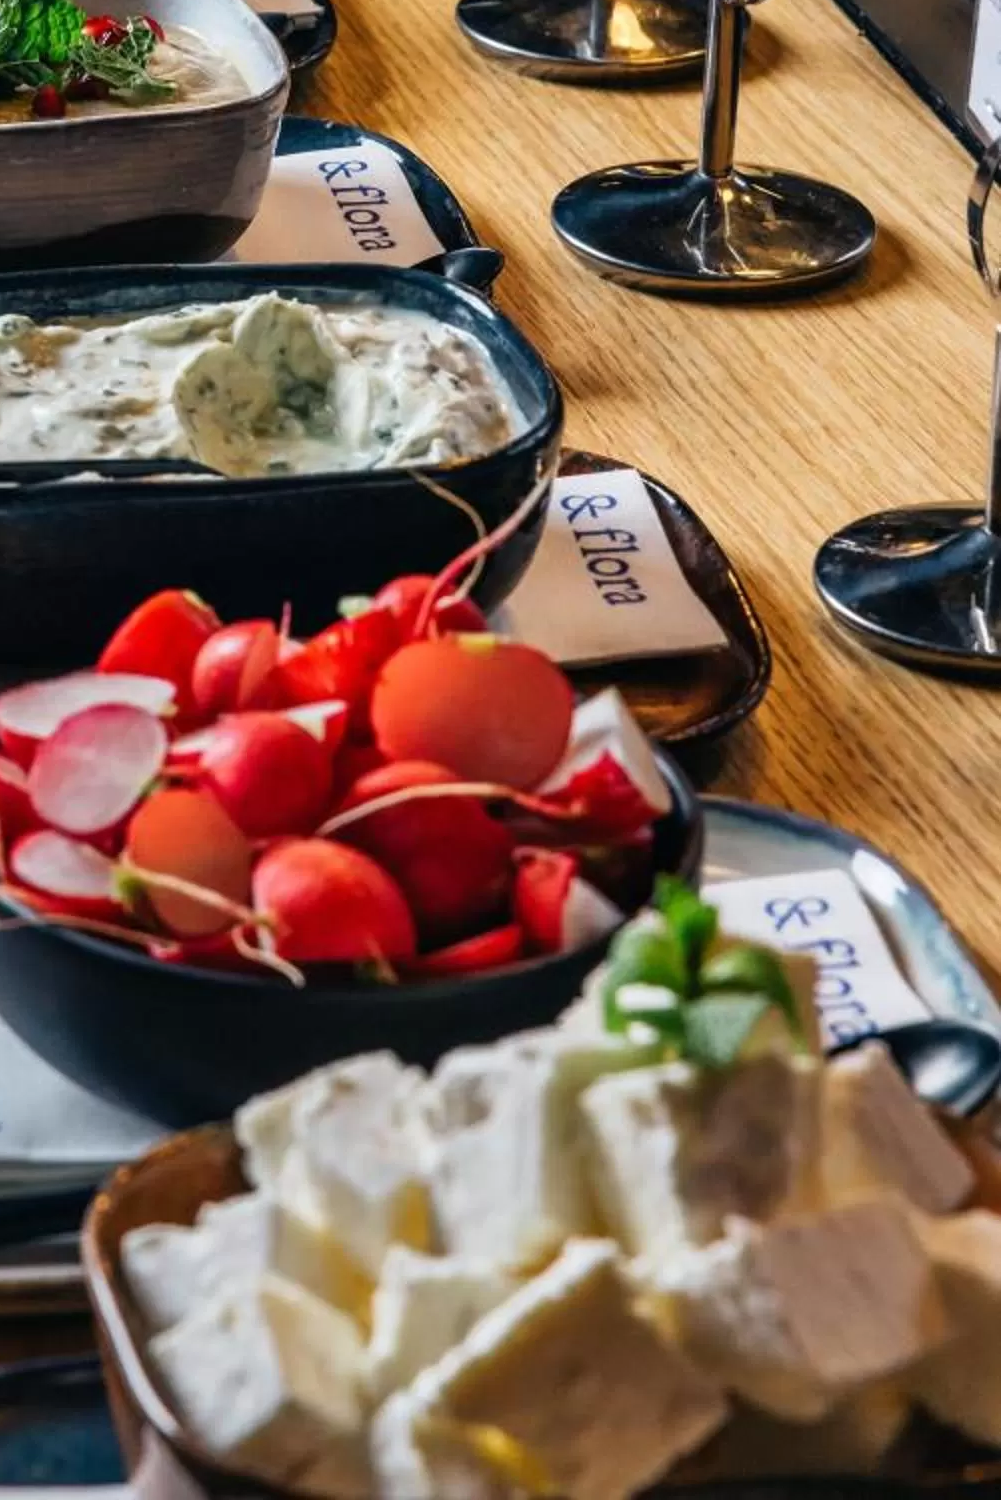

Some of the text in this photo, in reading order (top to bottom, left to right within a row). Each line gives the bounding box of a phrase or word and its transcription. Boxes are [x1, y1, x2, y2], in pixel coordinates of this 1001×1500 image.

[318, 160, 397, 252] & flora
[560, 494, 647, 606] & flora
[764, 897, 830, 932] &
